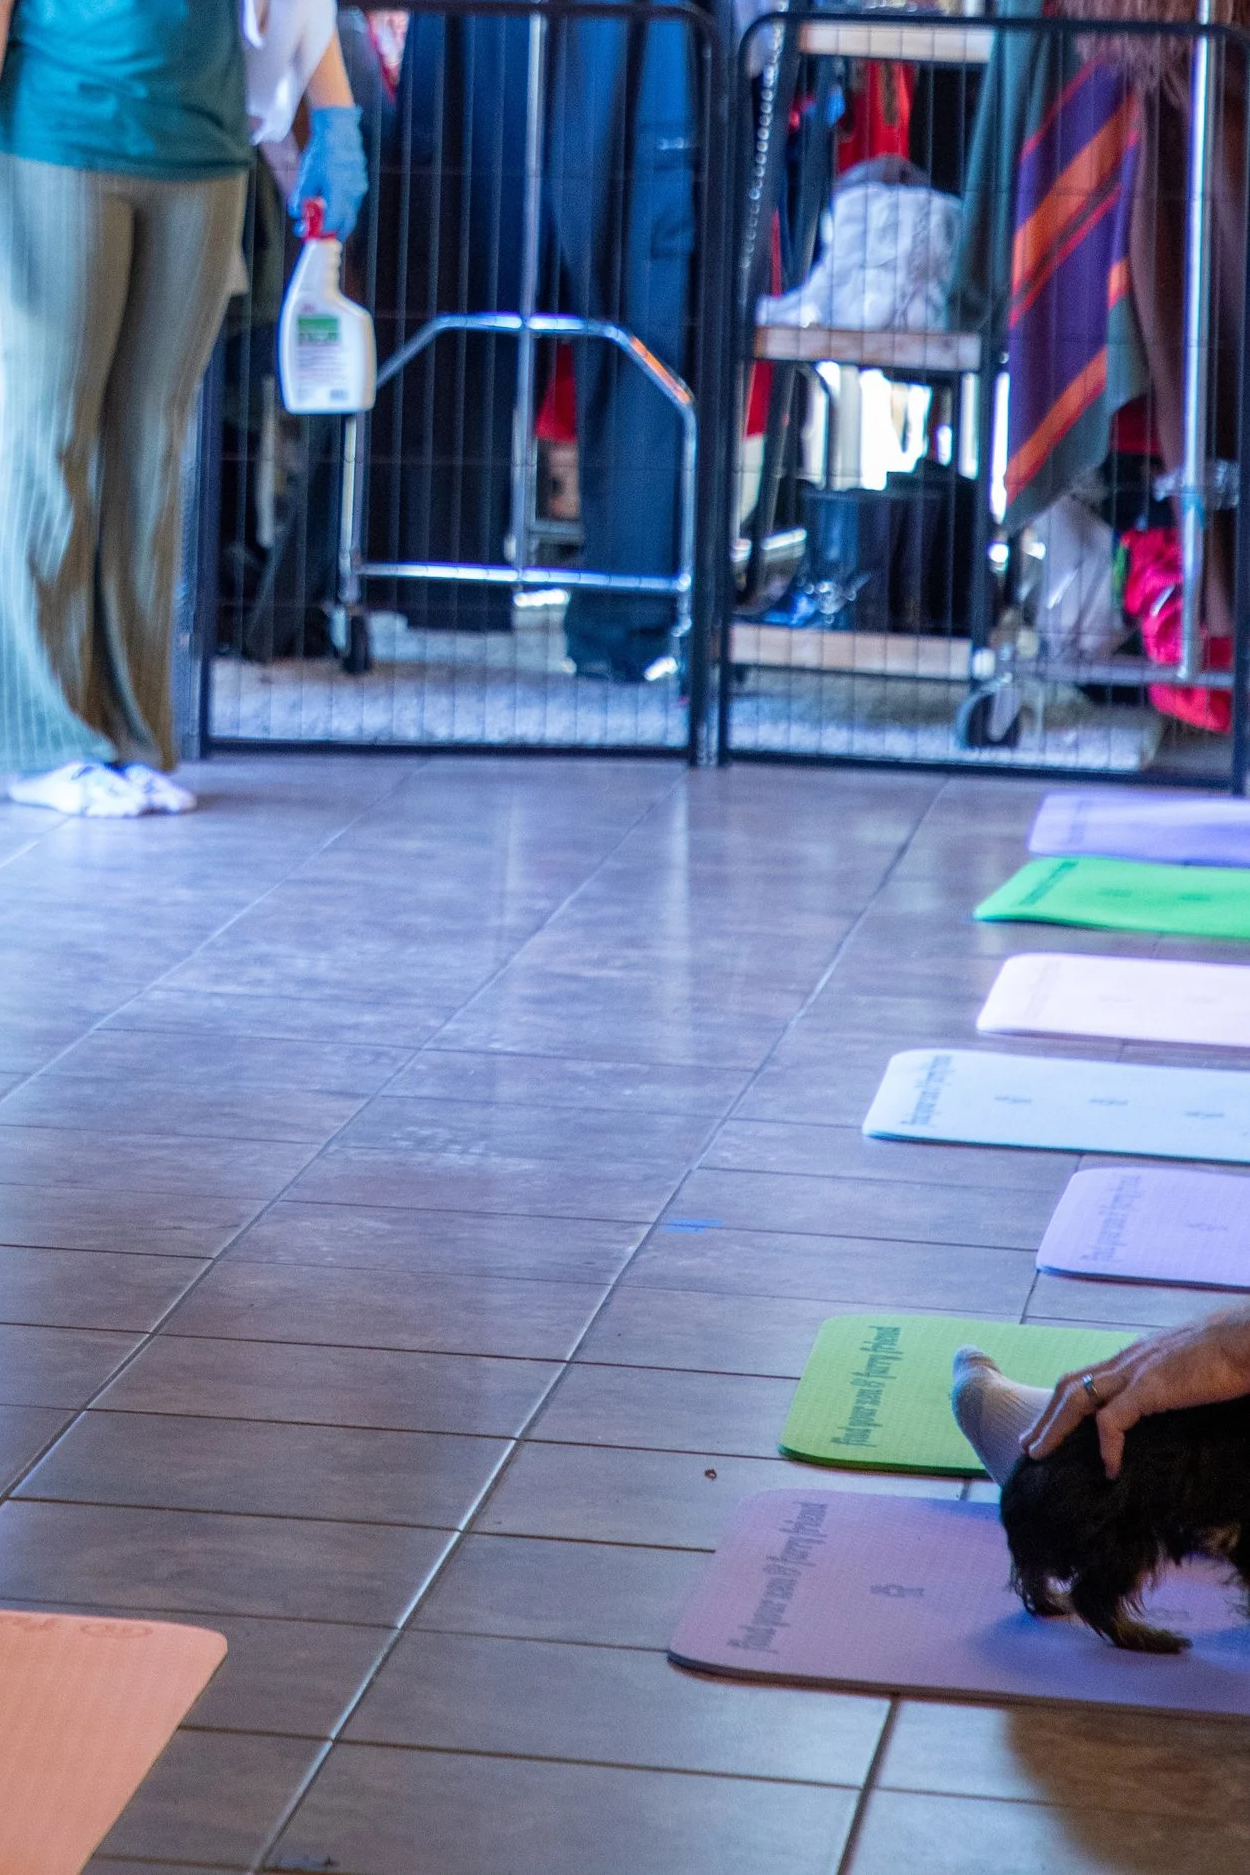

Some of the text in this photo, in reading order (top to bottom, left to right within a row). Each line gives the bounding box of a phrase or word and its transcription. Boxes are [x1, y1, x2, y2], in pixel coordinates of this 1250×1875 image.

[859, 1325, 903, 1354] friend
[851, 1353, 903, 1379] furry
[848, 1406, 883, 1428] your
[830, 1426, 877, 1447] find
[727, 1625, 779, 1654] find
[780, 1501, 828, 1537] friend
